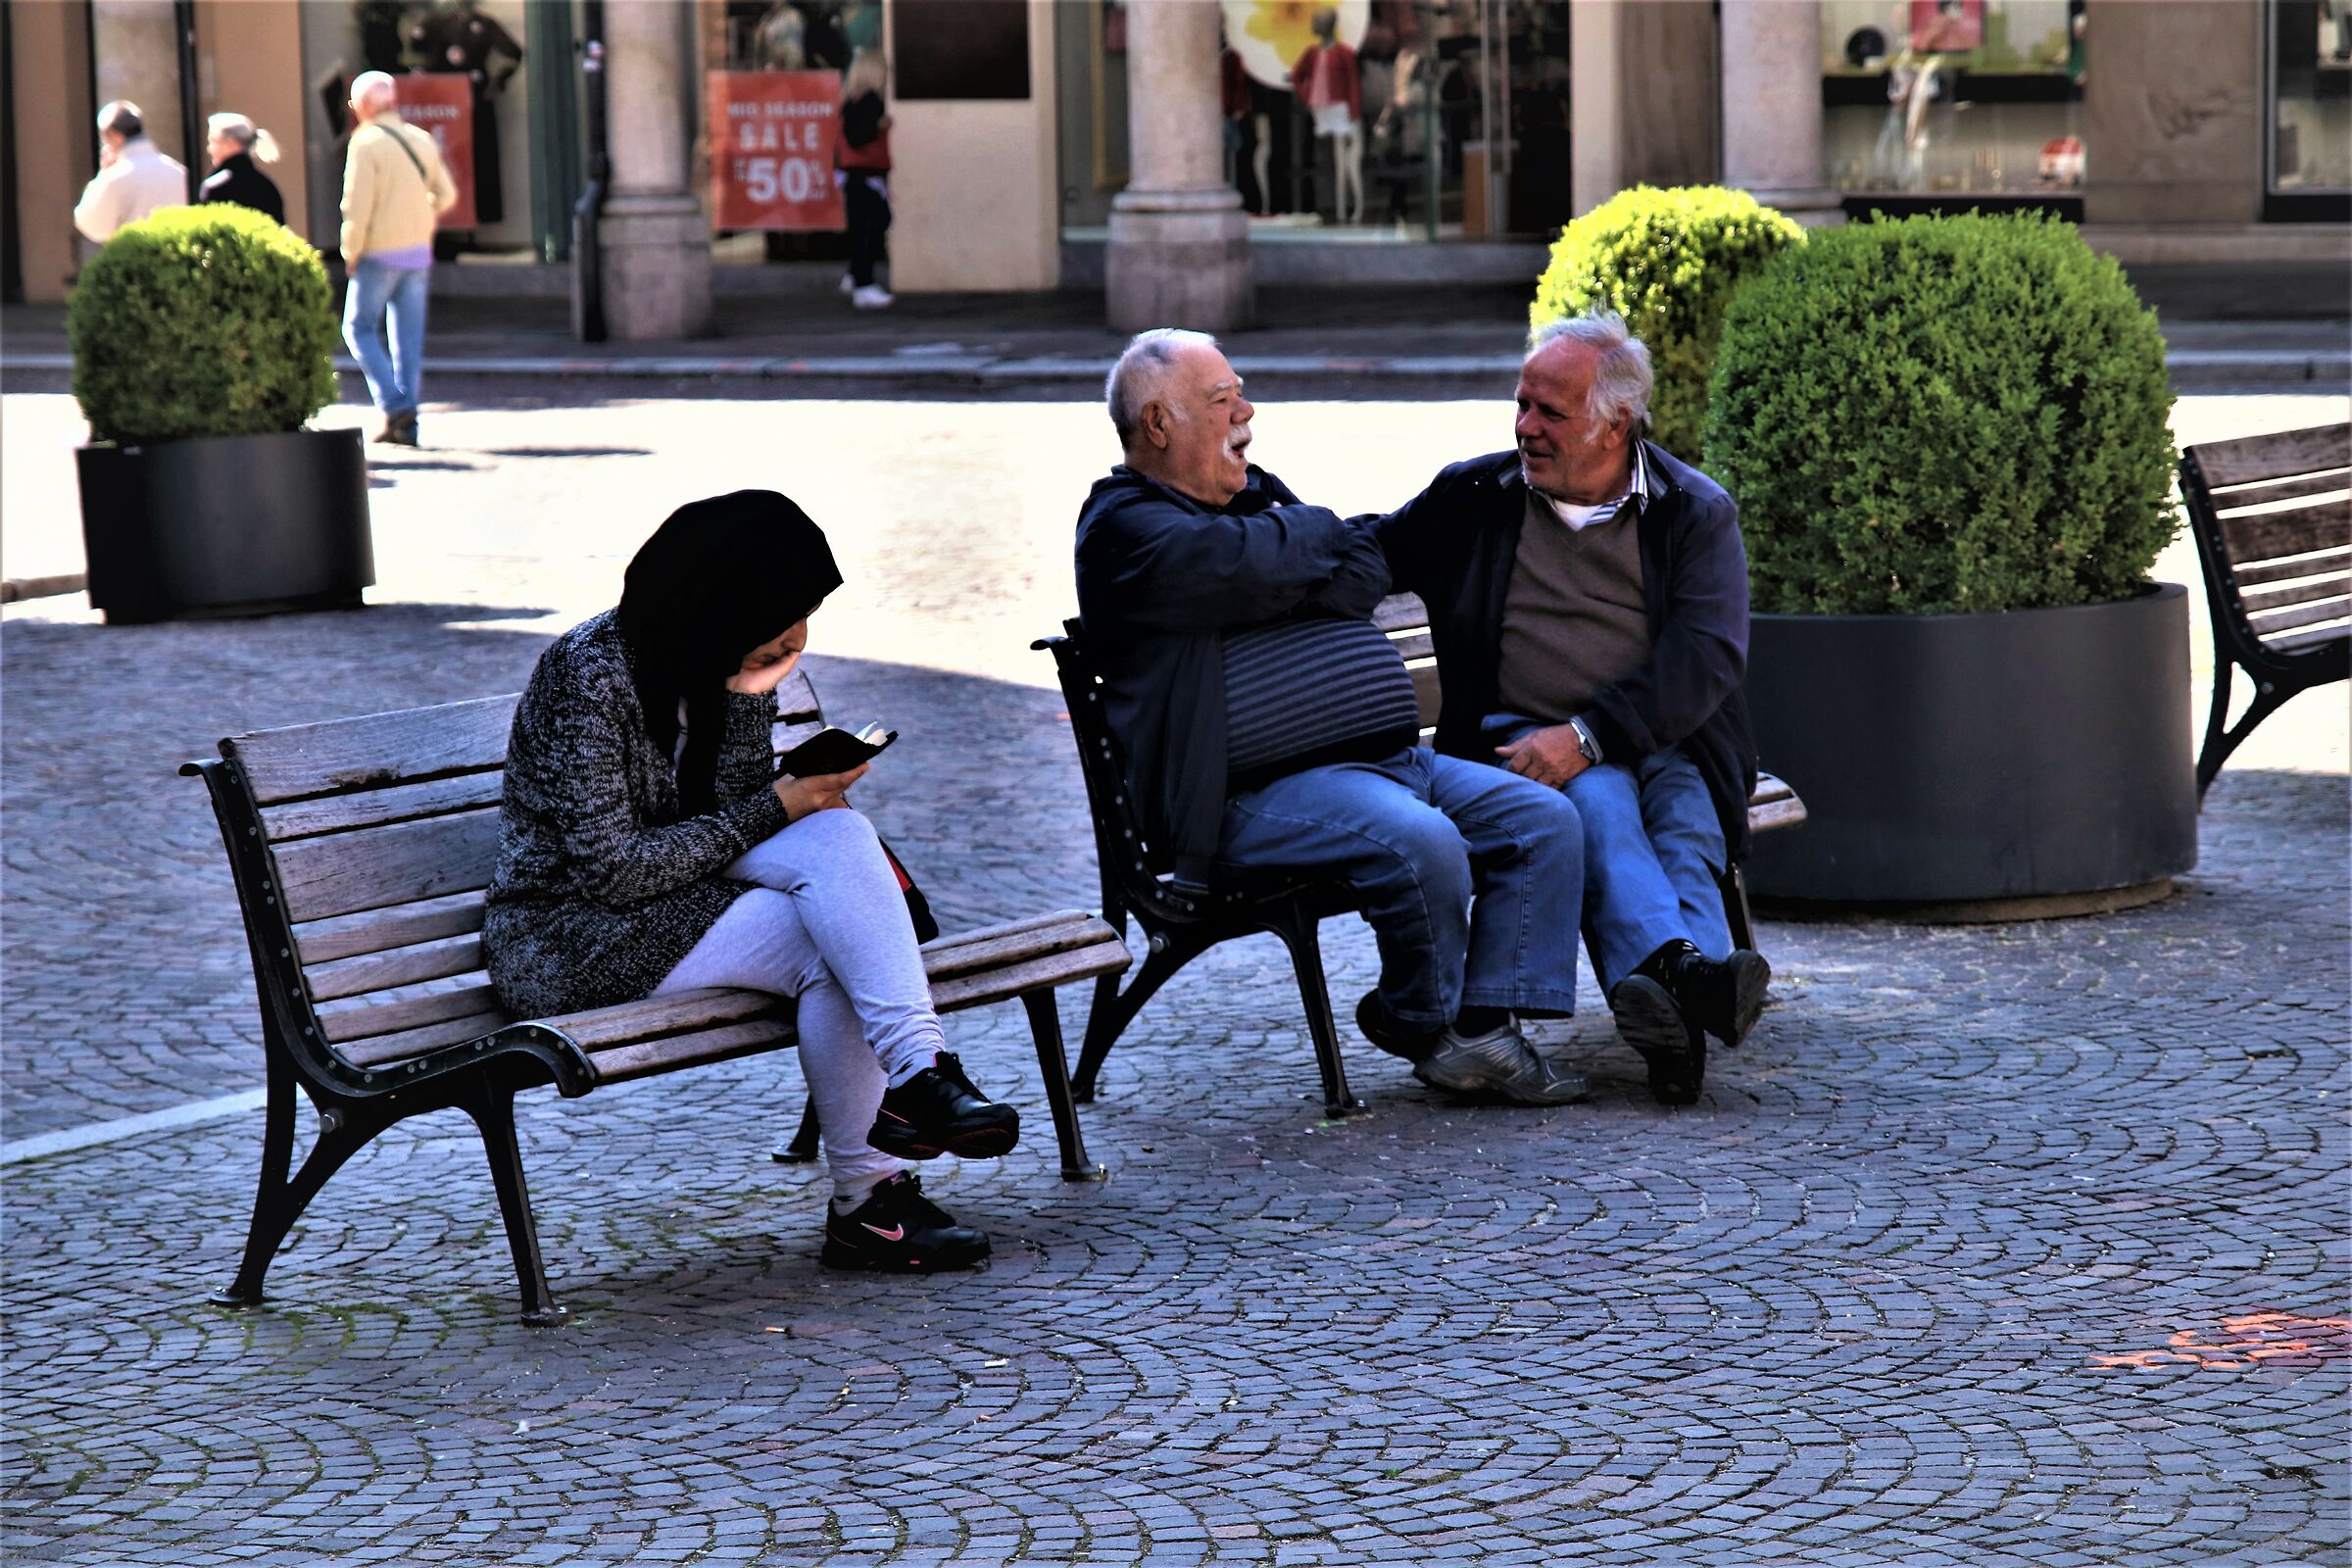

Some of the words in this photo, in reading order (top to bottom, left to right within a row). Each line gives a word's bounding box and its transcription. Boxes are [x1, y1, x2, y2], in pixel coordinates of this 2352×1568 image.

[399, 104, 459, 119] EASON
[764, 102, 832, 117] SEASON
[740, 122, 819, 151] SALE
